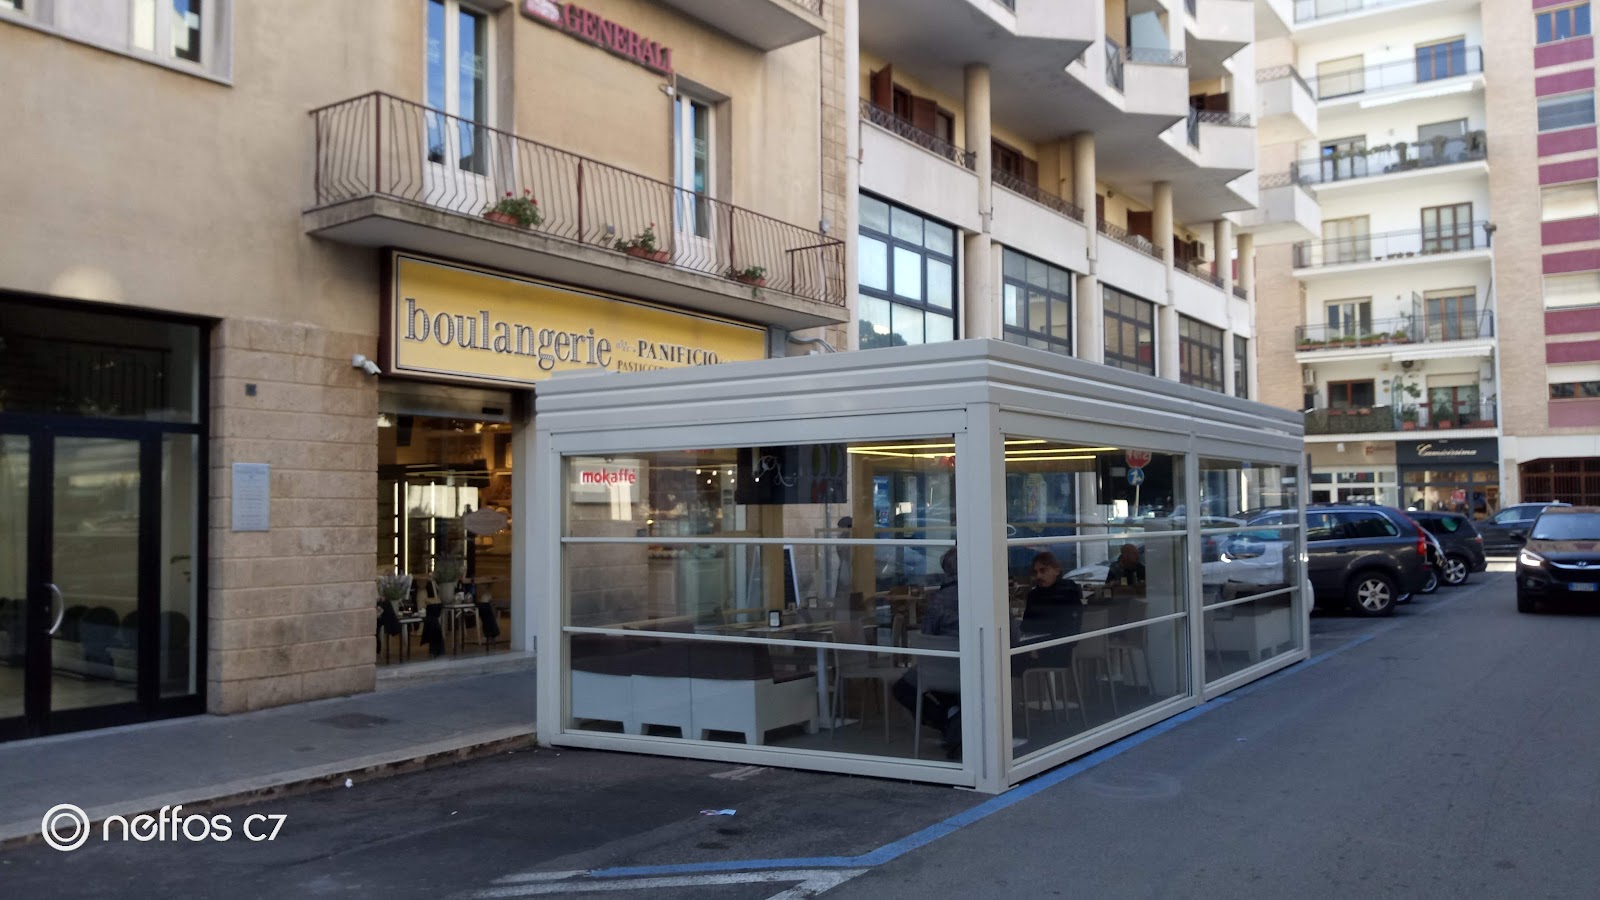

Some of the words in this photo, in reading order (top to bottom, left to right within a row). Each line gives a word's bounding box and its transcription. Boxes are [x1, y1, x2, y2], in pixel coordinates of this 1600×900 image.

[564, 3, 673, 73] GENERALI
[404, 298, 612, 371] boulangerie
[637, 340, 719, 366] PANIFICIO
